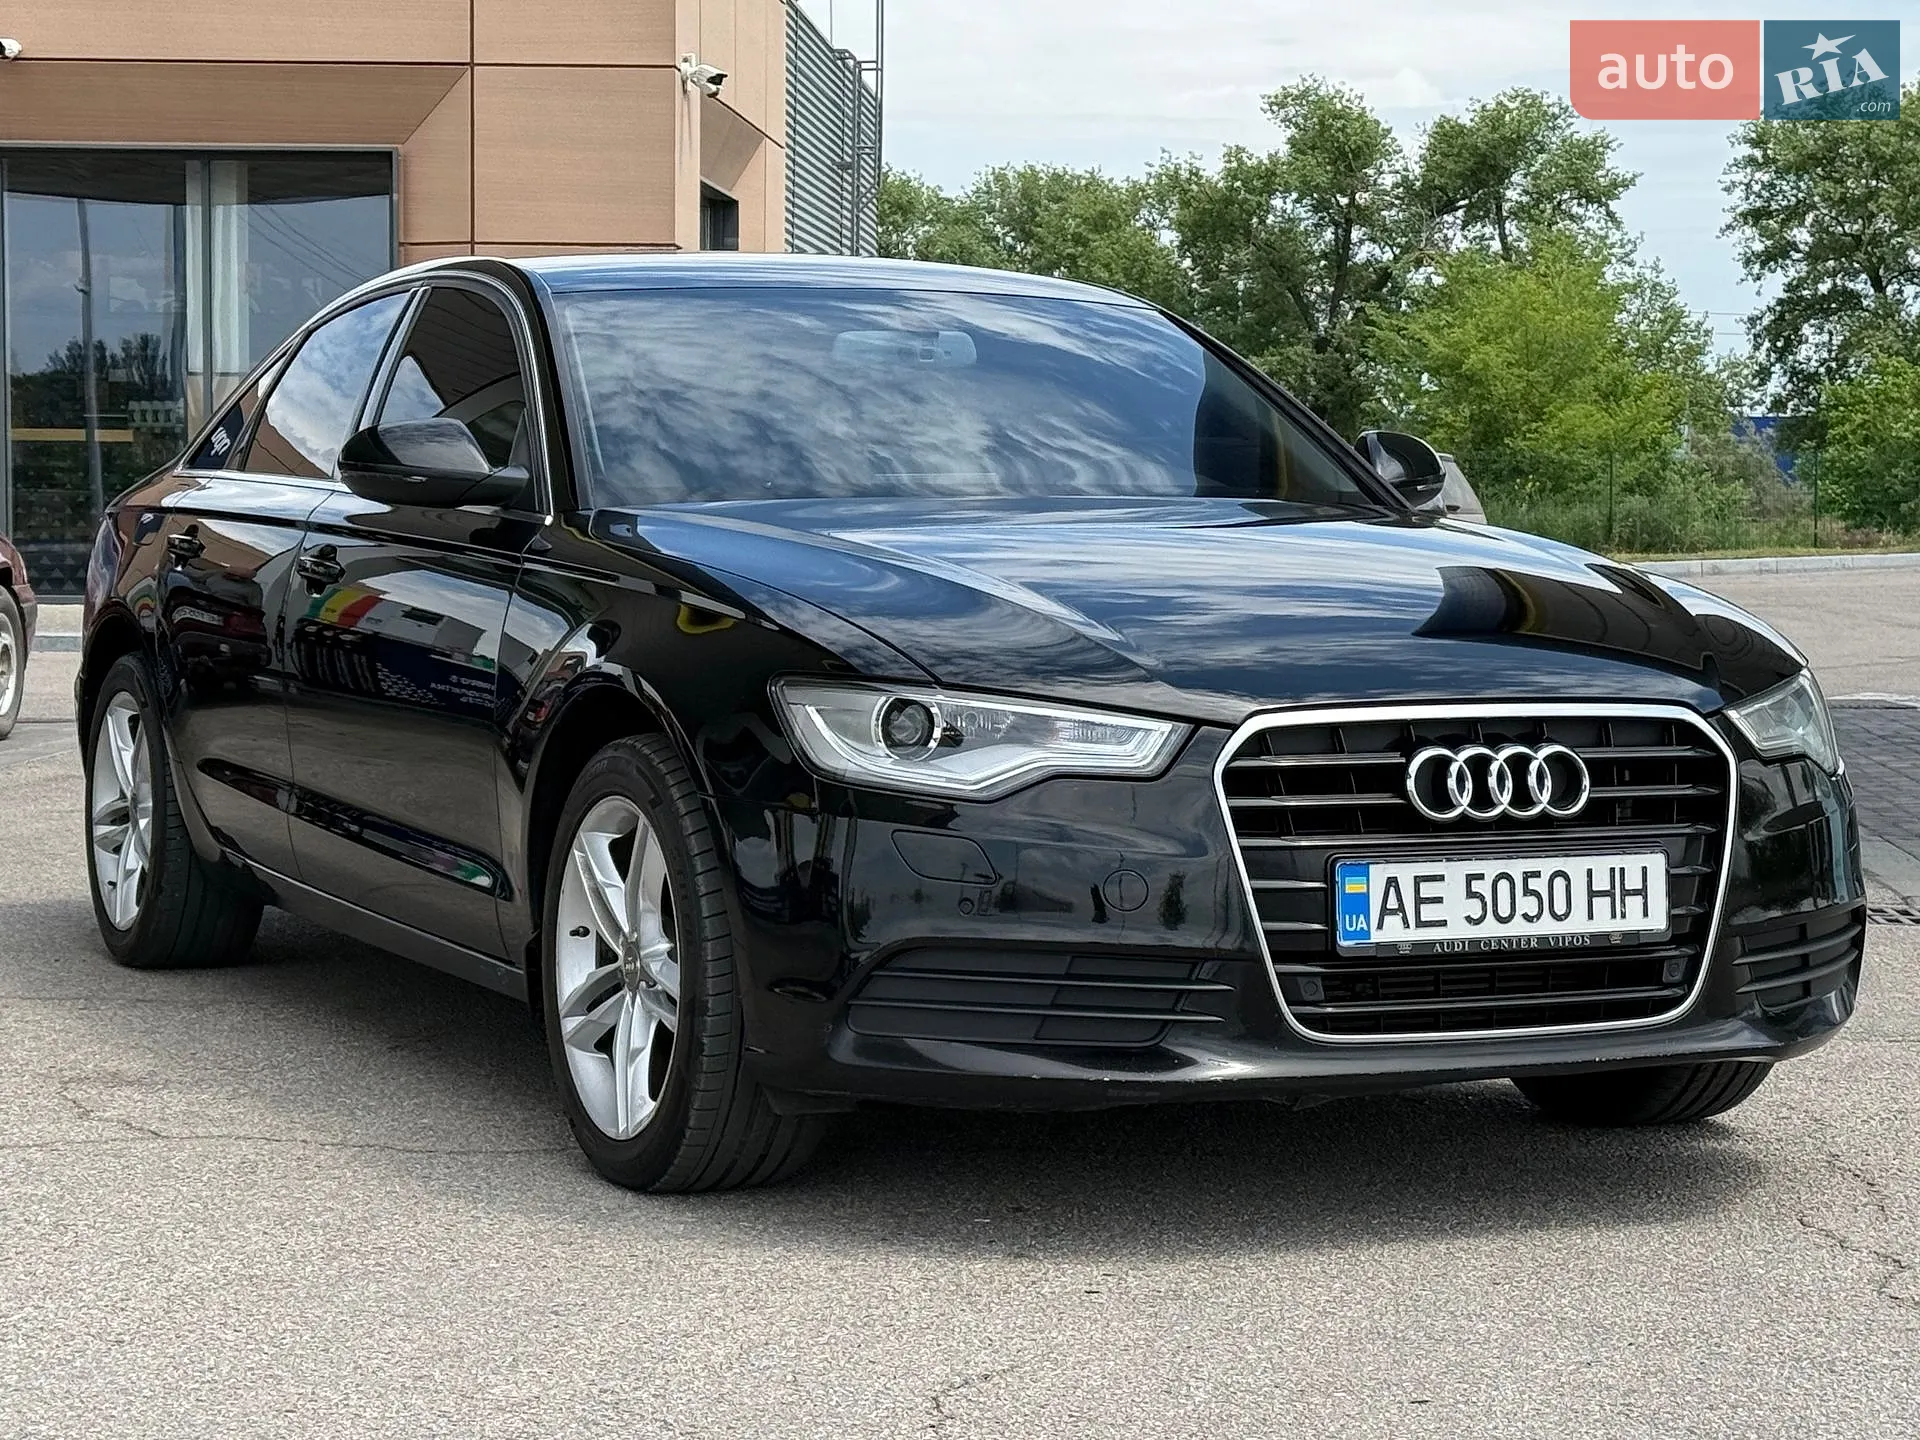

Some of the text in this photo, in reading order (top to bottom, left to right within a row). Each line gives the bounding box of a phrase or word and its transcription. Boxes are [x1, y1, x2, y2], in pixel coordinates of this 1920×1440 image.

[1375, 866, 1649, 930] AE 5050 HH
[1345, 914, 1368, 931] UA
[1433, 935, 1591, 953] AUDI CENTER VIPOS
